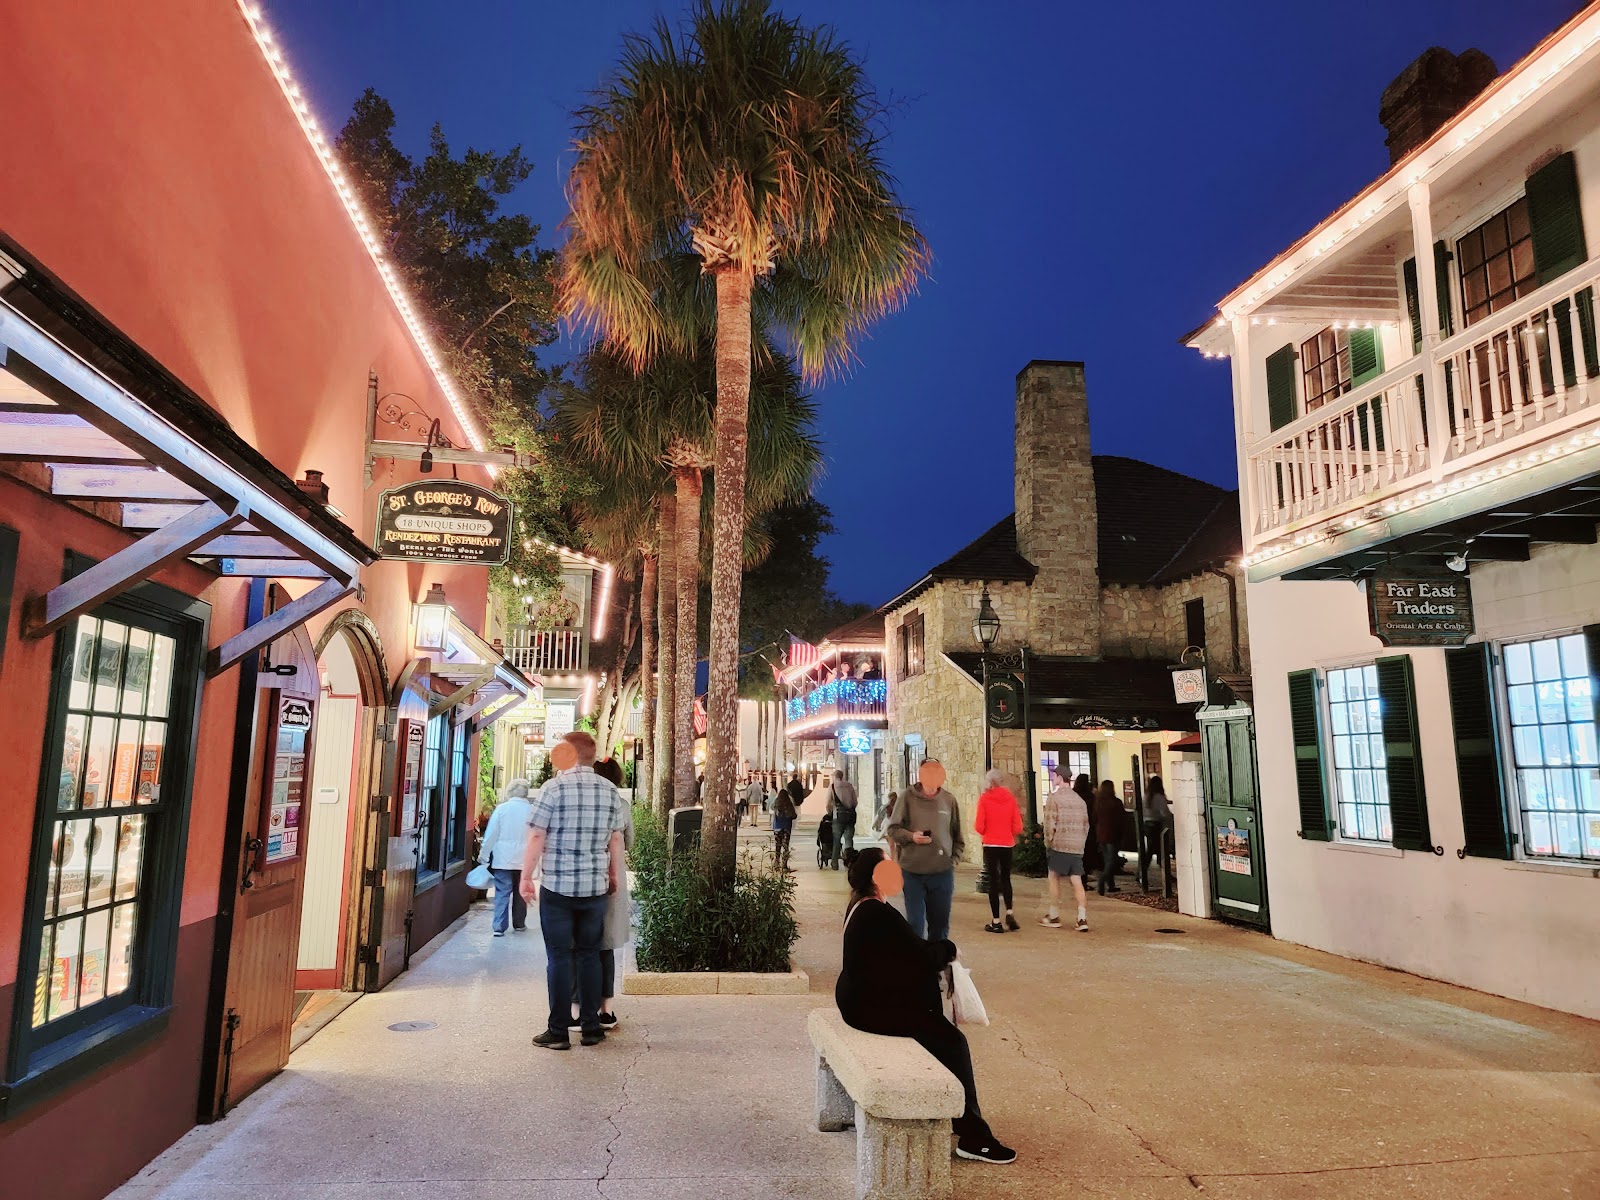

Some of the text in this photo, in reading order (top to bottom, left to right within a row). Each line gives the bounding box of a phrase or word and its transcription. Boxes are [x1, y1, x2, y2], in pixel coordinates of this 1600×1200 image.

[389, 490, 503, 516] ST. GEORGE'S ROW
[416, 519, 454, 530] UNIQUE
[456, 521, 487, 532] SHOPS
[384, 529, 502, 547] RENDEZVOUS RESTAURANT
[400, 543, 425, 551] BEERS
[437, 545, 455, 553] THE
[458, 546, 484, 555] WORLD
[1386, 583, 1457, 598] Far East
[1392, 600, 1455, 615] Traders
[1386, 622, 1415, 630] Oriental
[1435, 622, 1441, 630] &
[1443, 622, 1465, 631] Crafts
[121, 749, 132, 769] COW
[144, 751, 157, 760] COW
[141, 761, 156, 771] TALES
[283, 831, 297, 844] ATM
[1235, 855, 1249, 866] TICKETS
